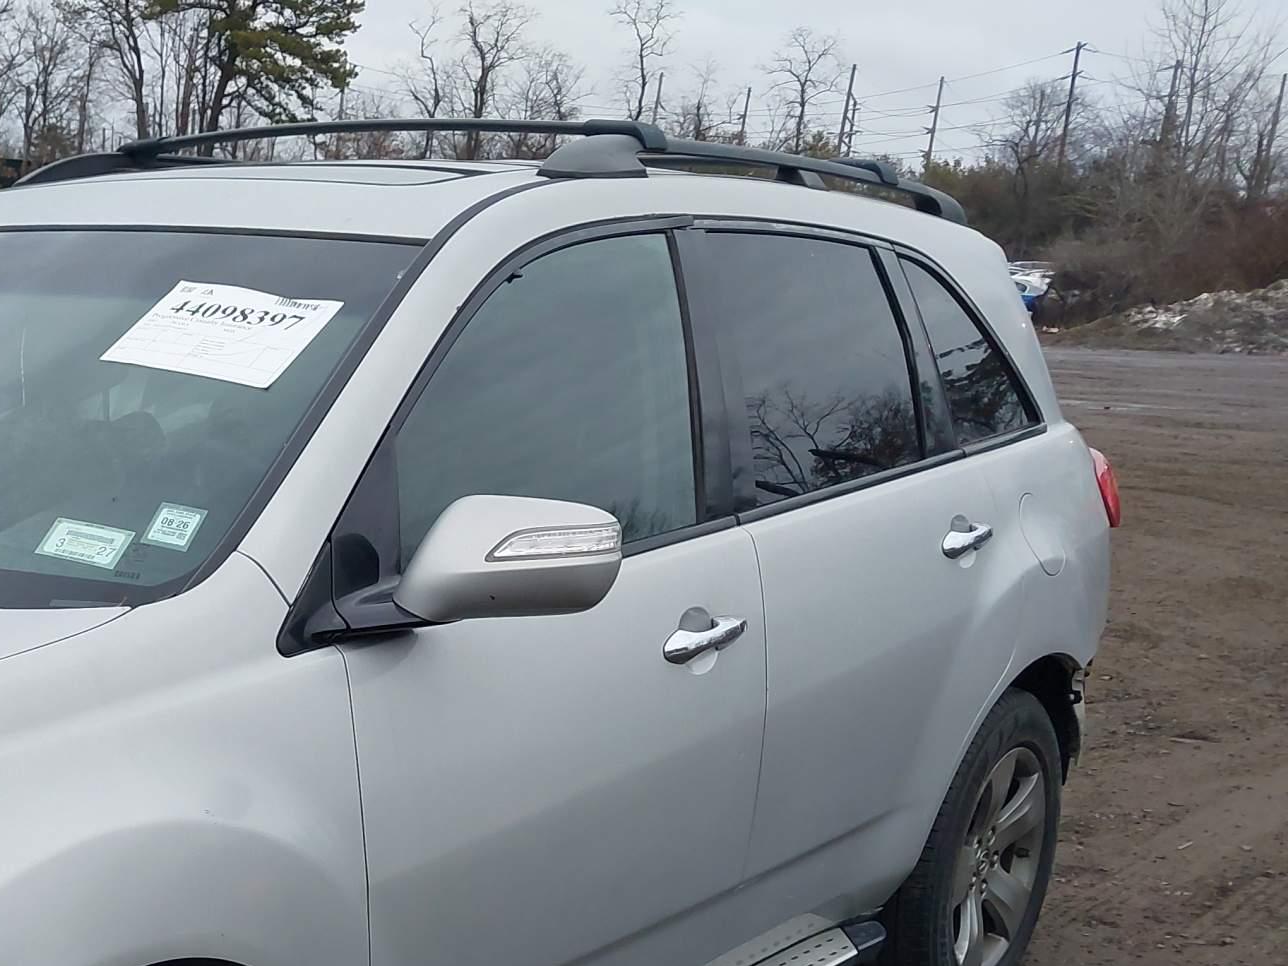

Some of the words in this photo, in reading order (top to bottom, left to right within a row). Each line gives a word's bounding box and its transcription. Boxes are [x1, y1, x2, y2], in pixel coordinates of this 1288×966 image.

[170, 300, 306, 331] 44098397
[55, 538, 66, 548] 3
[96, 546, 116, 558] 27
